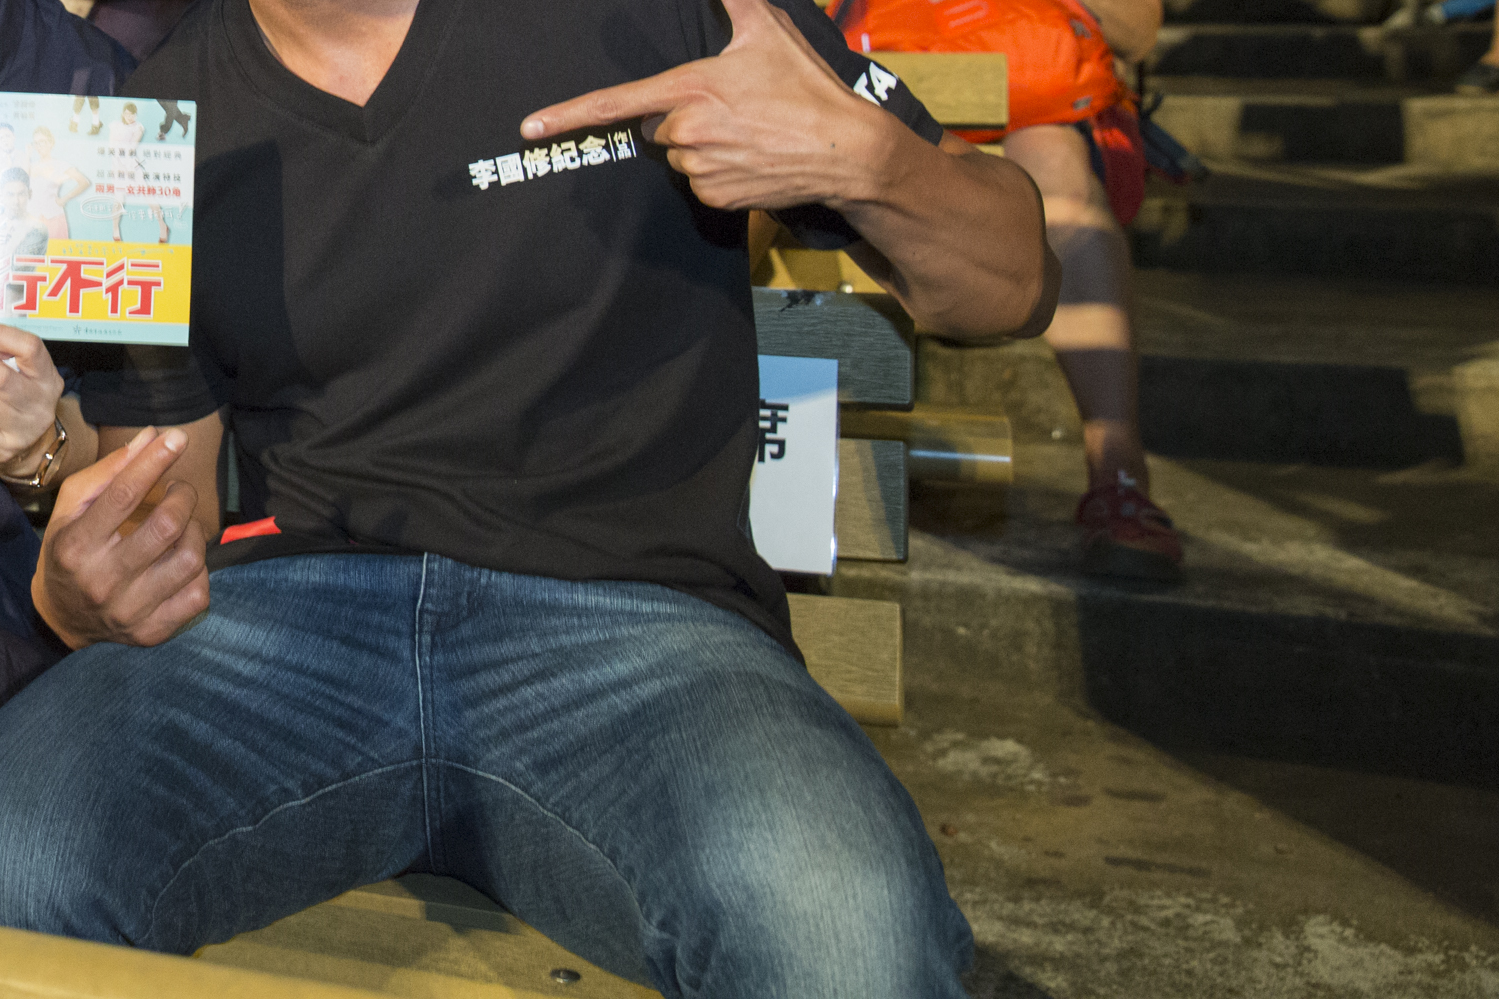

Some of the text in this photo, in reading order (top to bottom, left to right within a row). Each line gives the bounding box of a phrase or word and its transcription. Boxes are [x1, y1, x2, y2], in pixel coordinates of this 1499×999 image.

[468, 134, 611, 191] 李國修紀念
